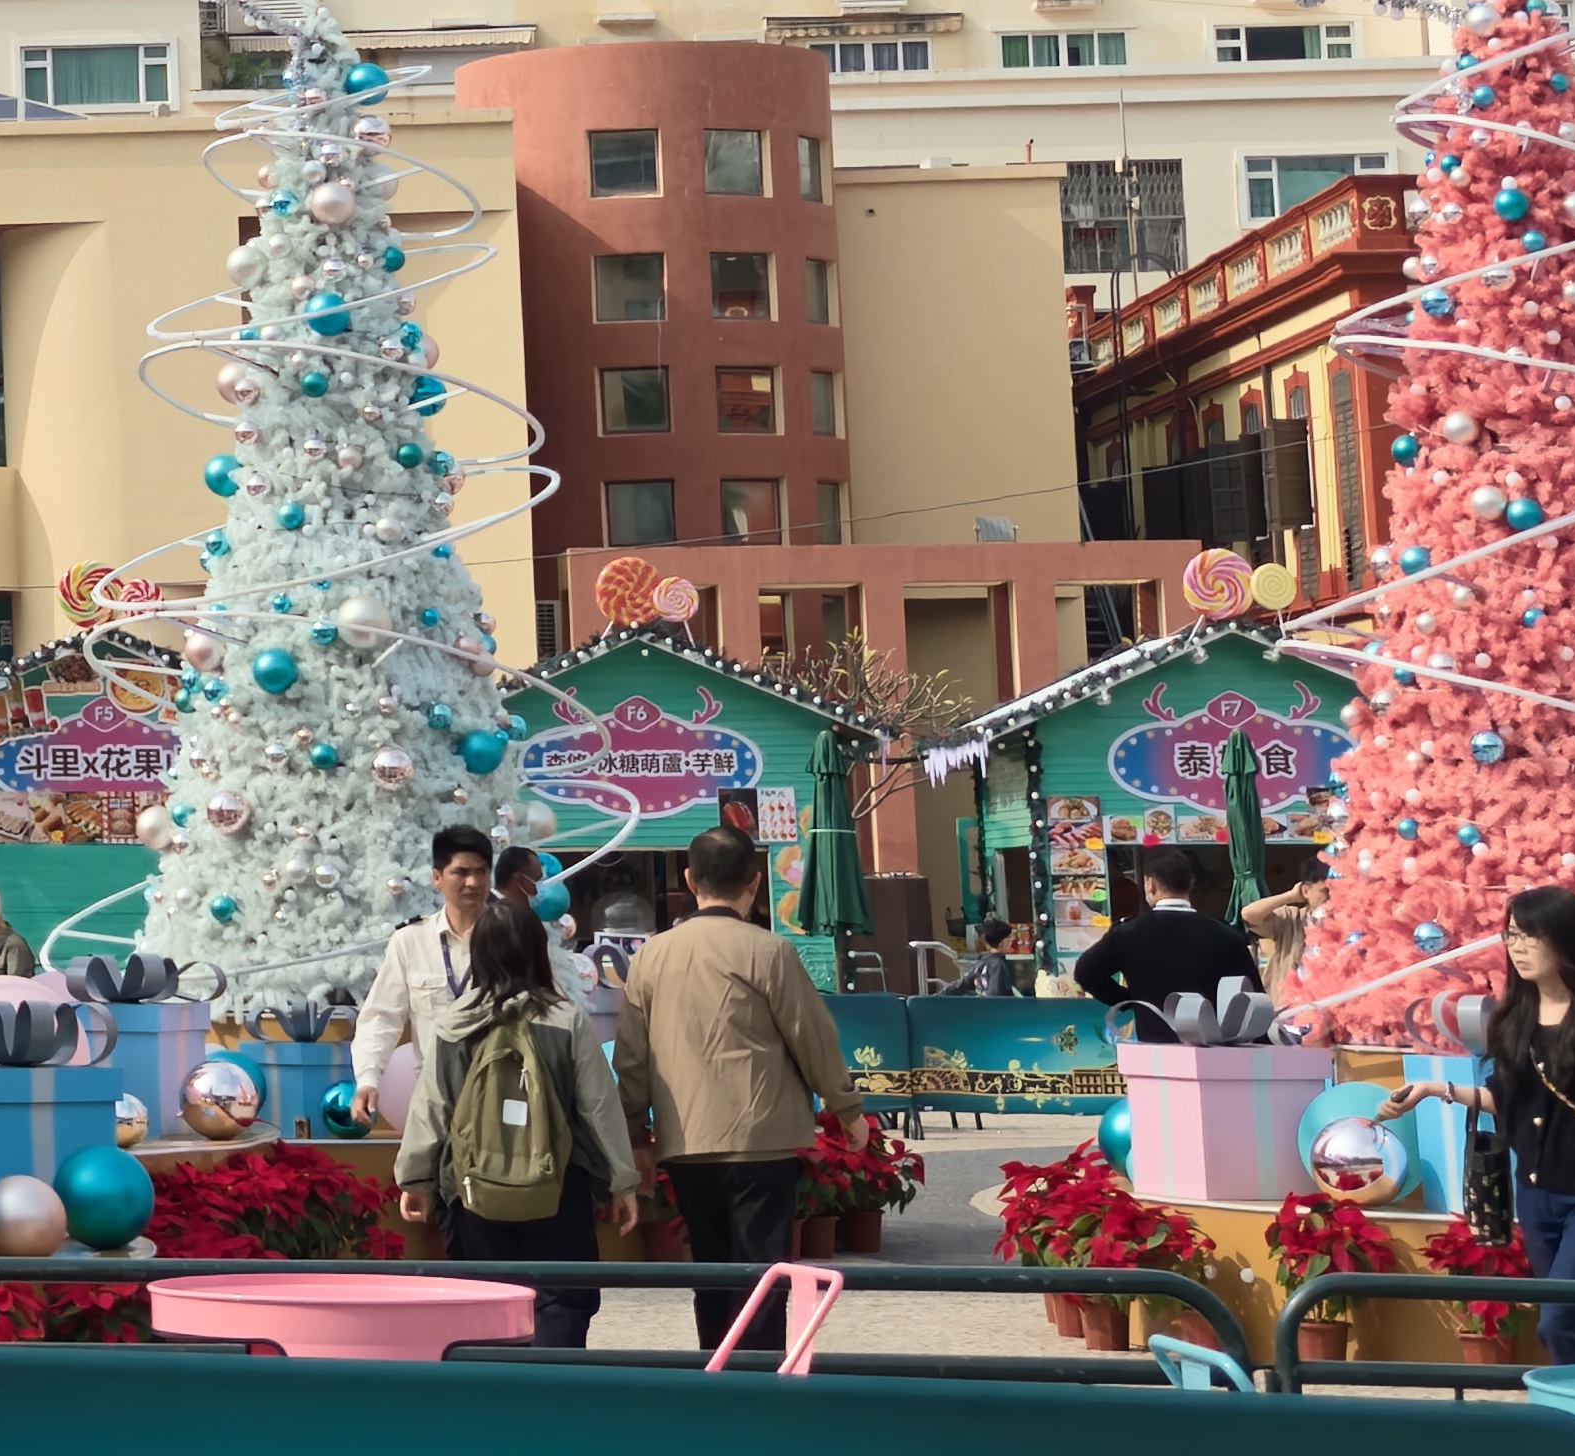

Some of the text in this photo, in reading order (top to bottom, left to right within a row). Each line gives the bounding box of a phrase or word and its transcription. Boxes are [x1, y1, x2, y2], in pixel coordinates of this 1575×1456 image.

[94, 706, 114, 721] F5
[627, 705, 648, 722] F6
[1221, 700, 1242, 717] F7
[18, 747, 182, 779] 斗里x花果
[1177, 743, 1294, 777] 泰食
